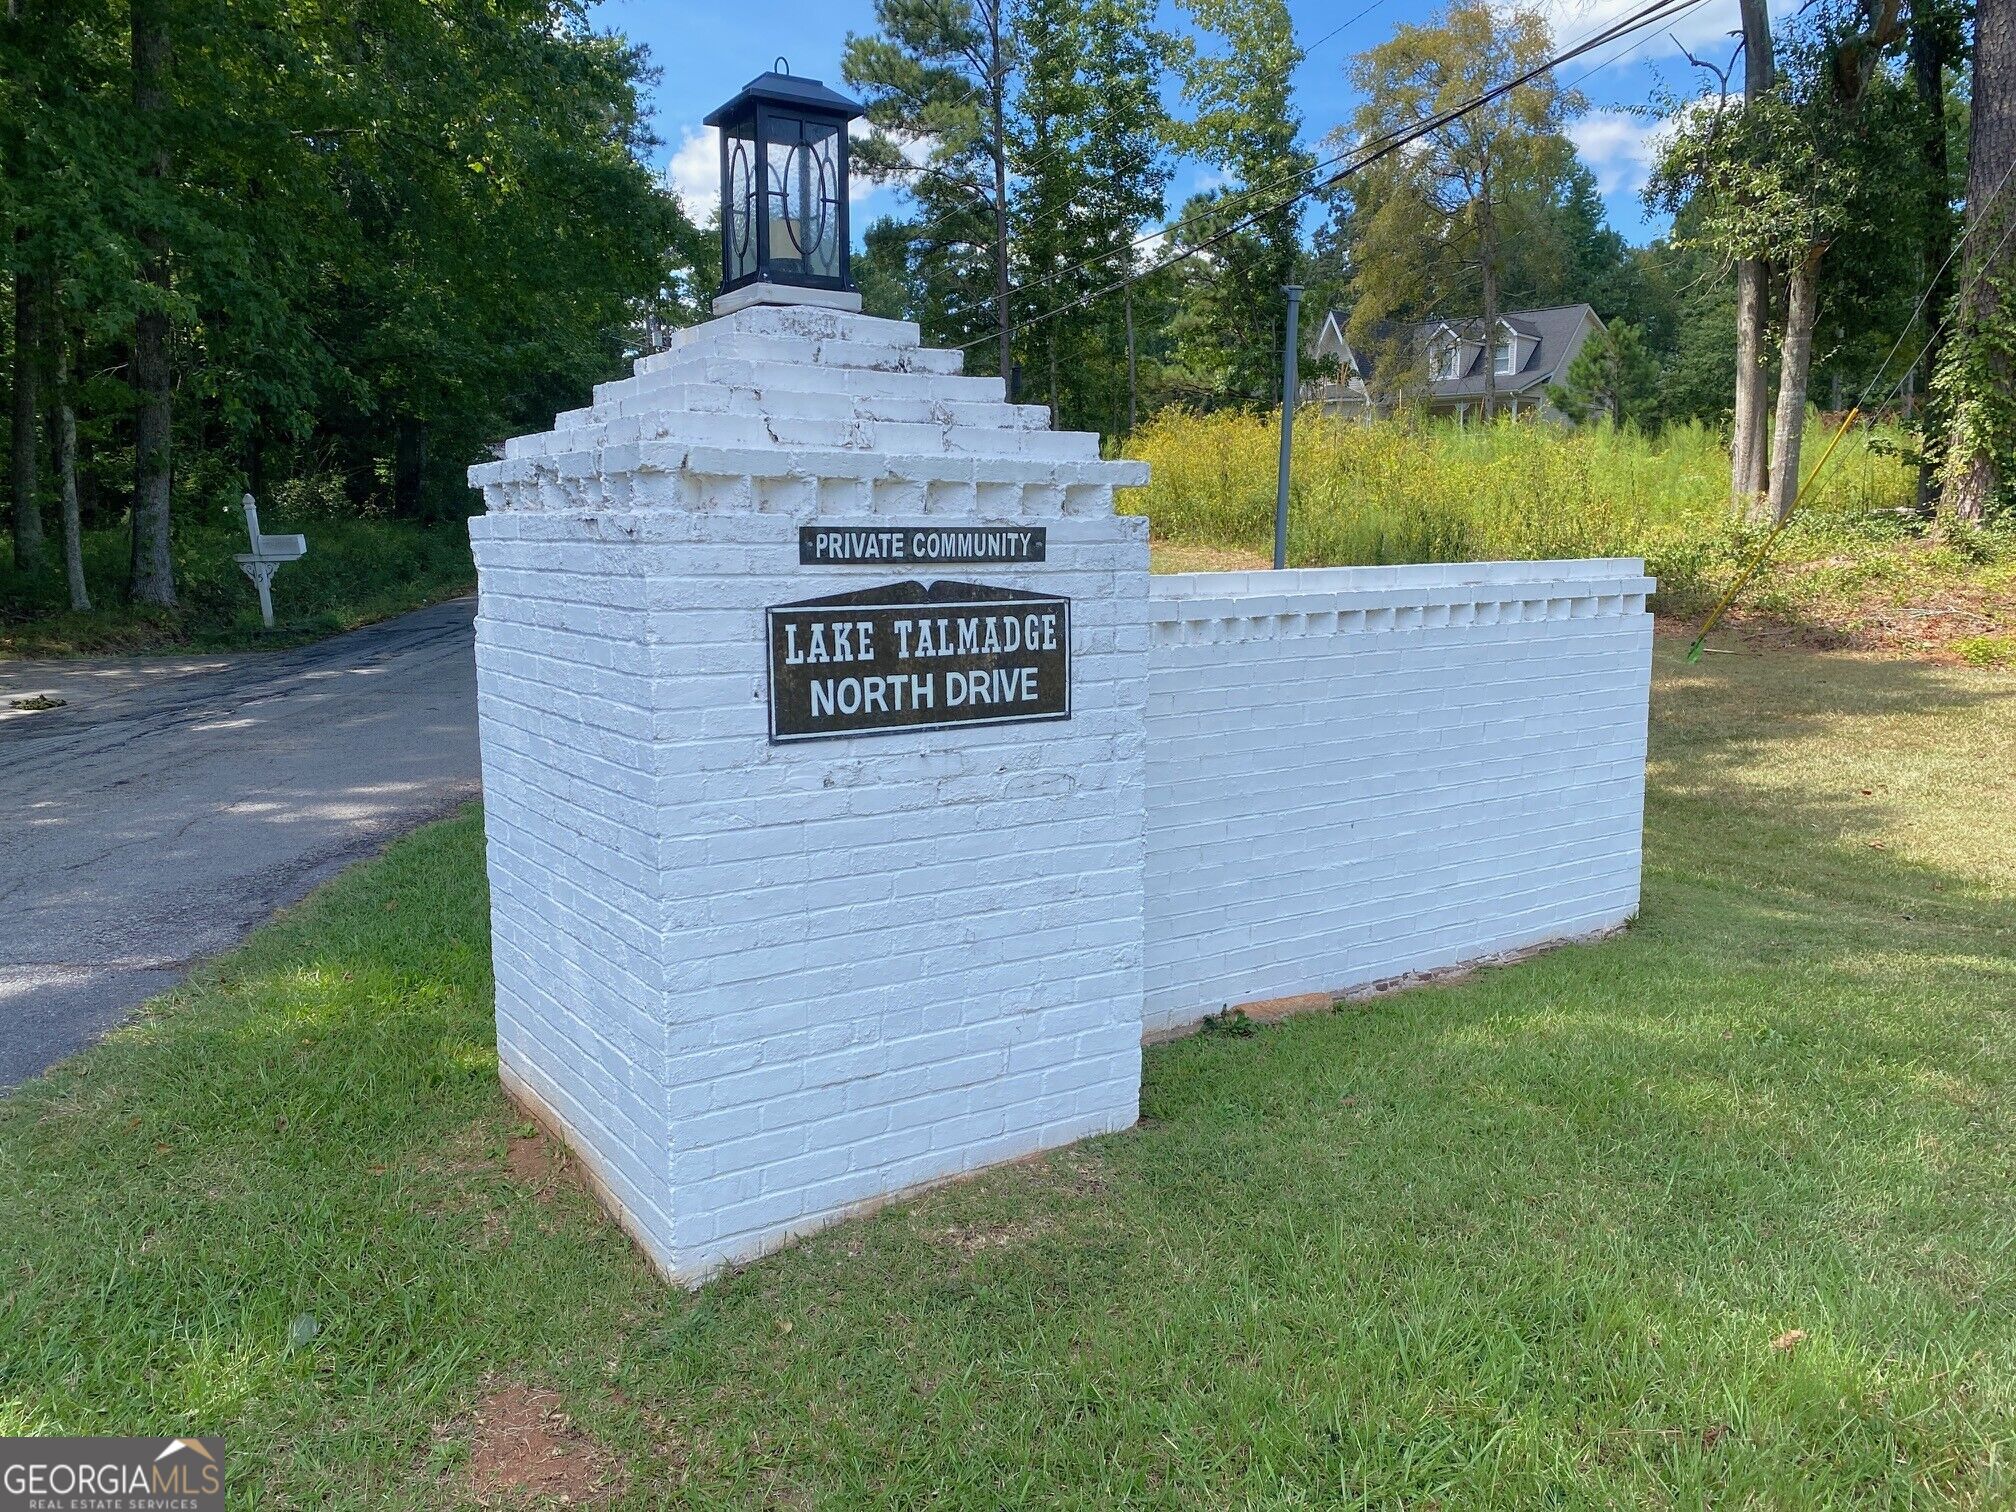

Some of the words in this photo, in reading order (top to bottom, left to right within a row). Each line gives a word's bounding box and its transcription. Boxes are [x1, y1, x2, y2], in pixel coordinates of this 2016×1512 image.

[816, 532, 904, 559] PRIVATE
[912, 532, 1032, 557] COMMUNITY
[785, 621, 874, 665] LAKE
[894, 614, 1057, 659] TALMADGE
[810, 673, 934, 716] NORTH
[946, 667, 1038, 706] DRIVE
